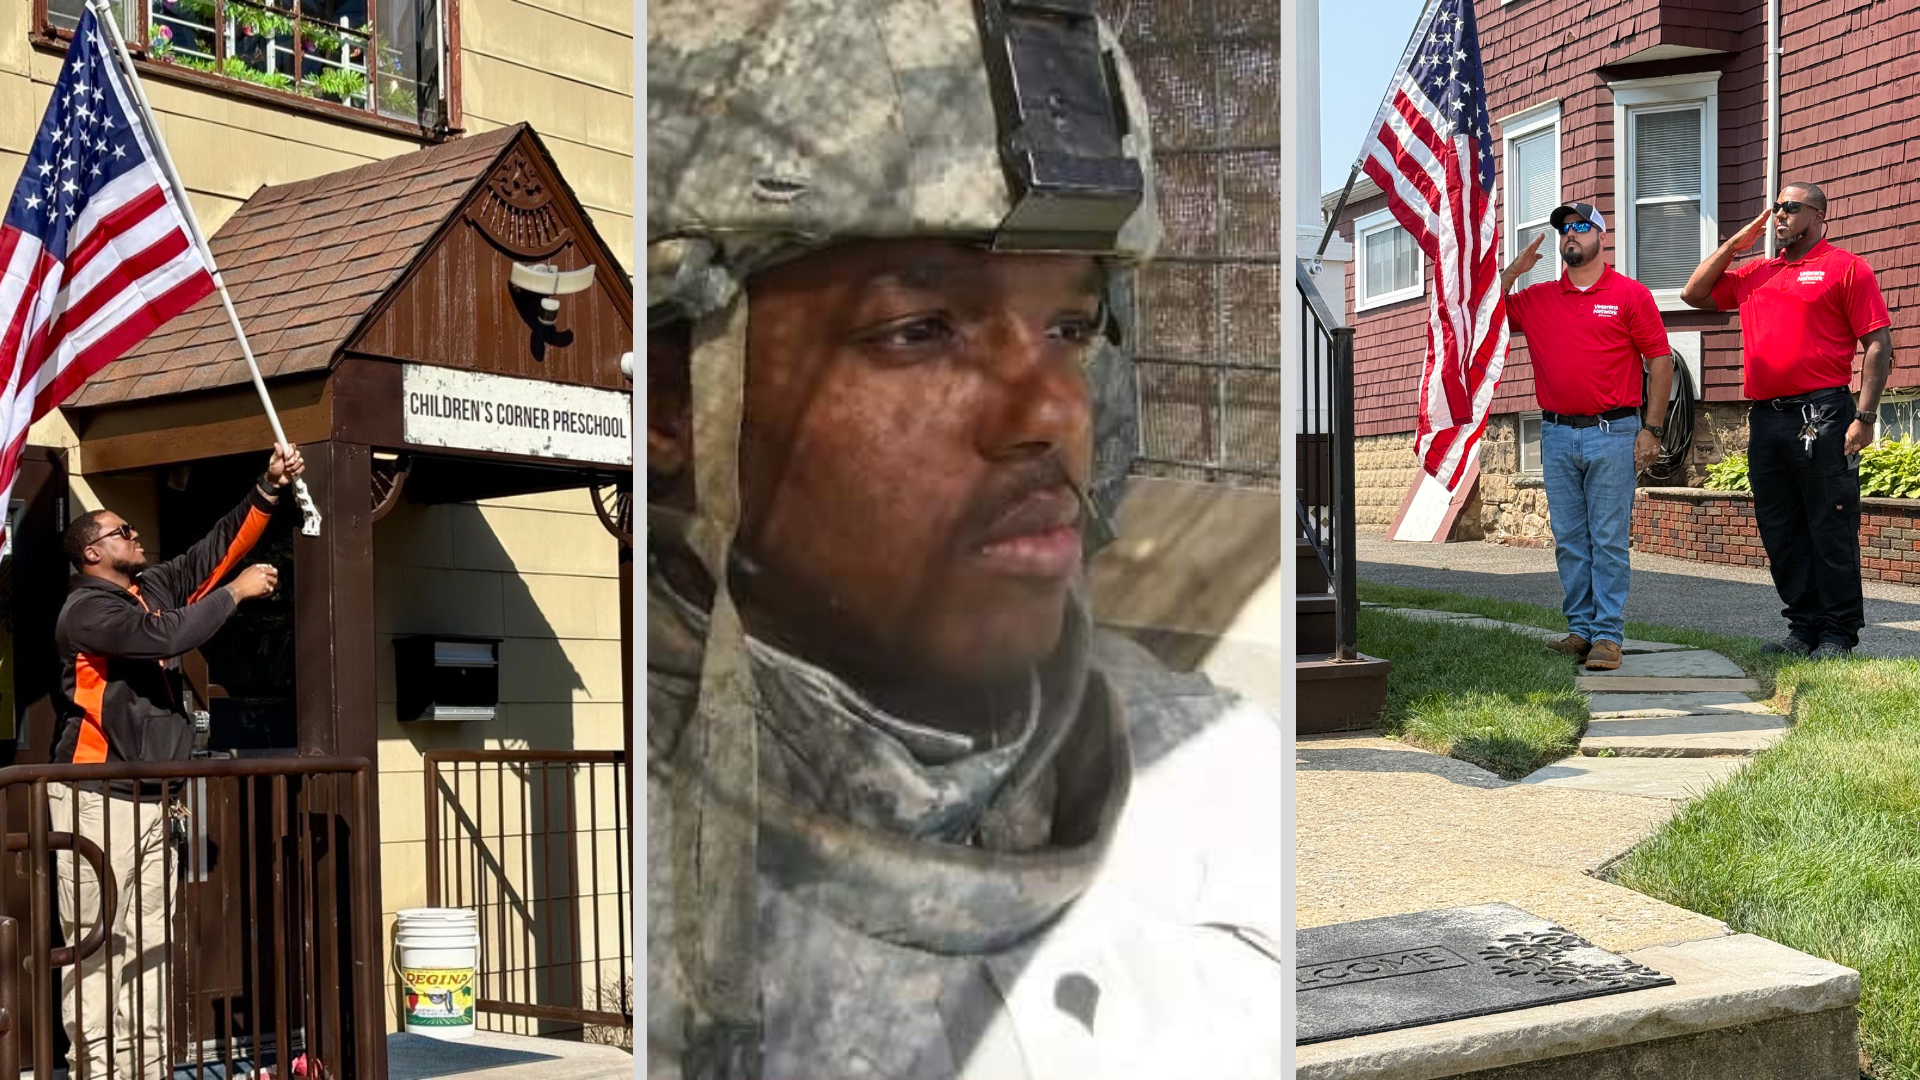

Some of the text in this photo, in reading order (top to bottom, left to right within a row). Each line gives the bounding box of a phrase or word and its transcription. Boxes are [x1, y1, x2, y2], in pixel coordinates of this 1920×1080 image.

[410, 392, 627, 438] CHILDREN'S CORNER PRESCHOOL
[405, 973, 468, 987] REGINA
